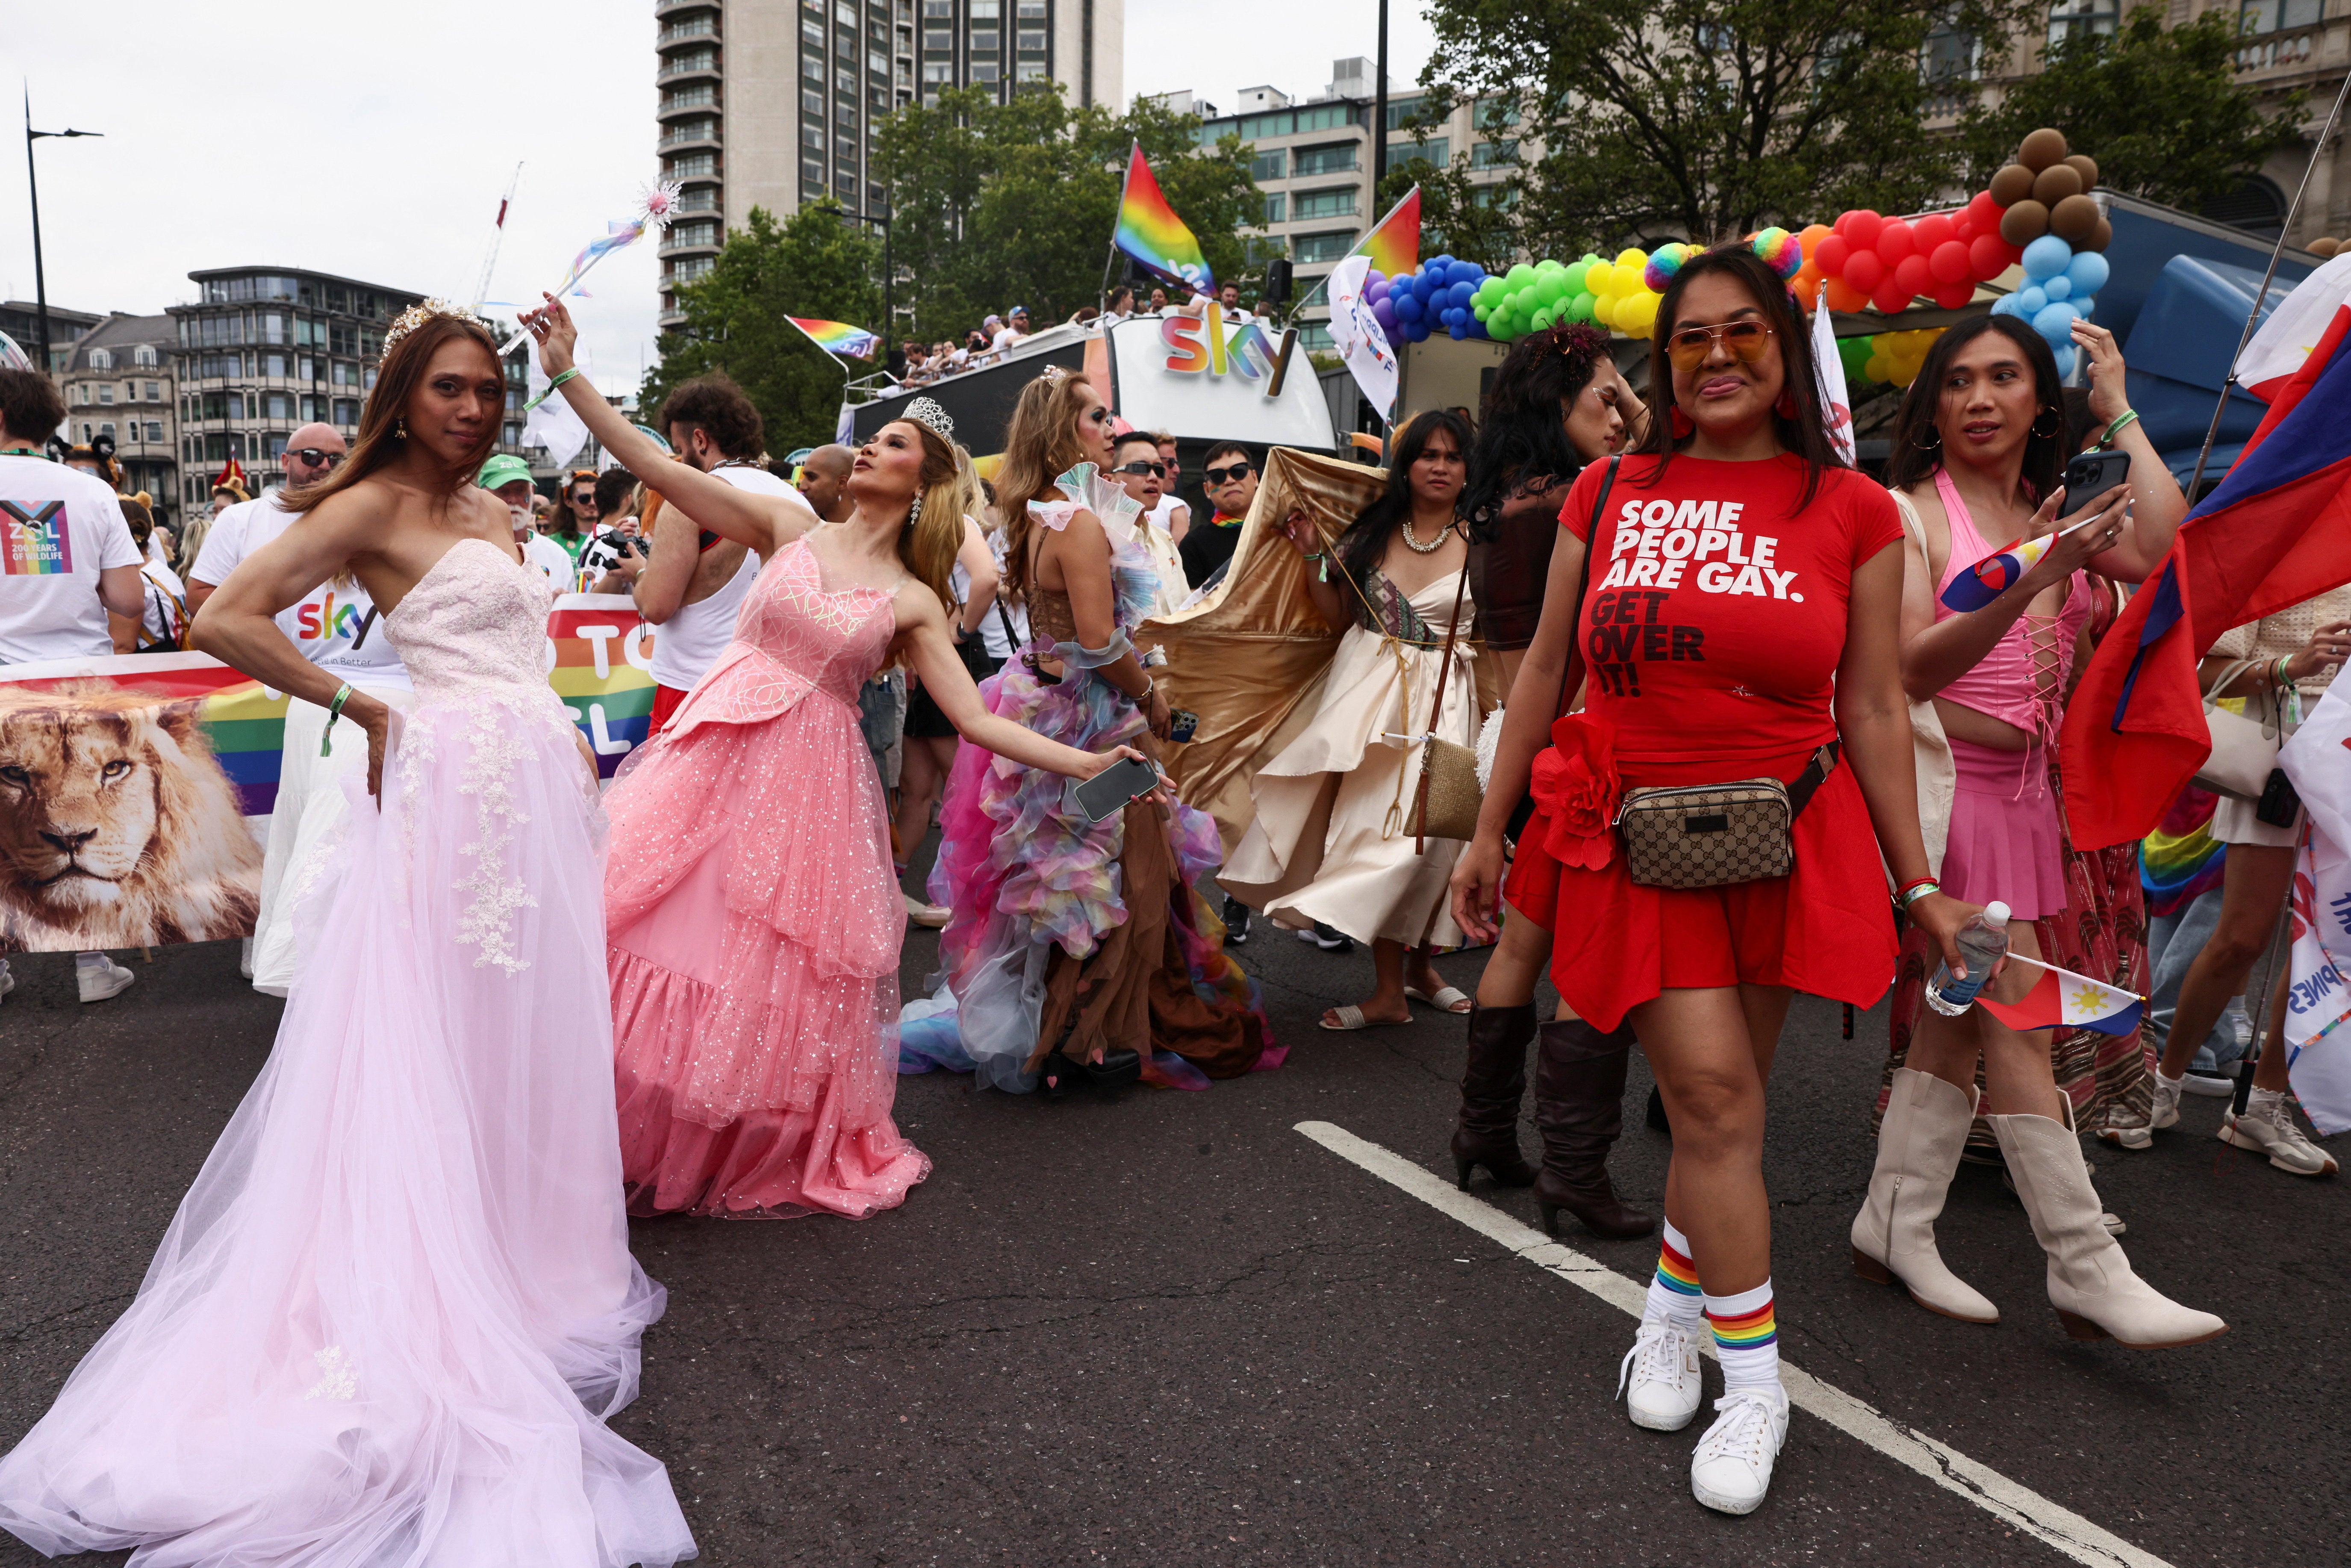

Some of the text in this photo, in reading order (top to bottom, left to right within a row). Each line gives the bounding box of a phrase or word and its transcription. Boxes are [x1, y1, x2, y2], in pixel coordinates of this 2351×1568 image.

[1161, 301, 1299, 398] sky
[8, 520, 60, 541] ZSL
[1617, 499, 1744, 531] SOME
[12, 543, 57, 552] 200 YEARS
[25, 551, 63, 560] WILDLIFE
[1610, 528, 1778, 569] PEOPLE
[1597, 558, 1804, 603] ARE GAY.
[298, 592, 379, 650] sky
[1591, 592, 1670, 625] GET
[1588, 625, 1705, 662] OVER
[340, 657, 371, 666] Better
[1594, 663, 1640, 698] IT!
[1632, 1412, 1673, 1430] GUESS
[1698, 1490, 1747, 1514] GUESS
